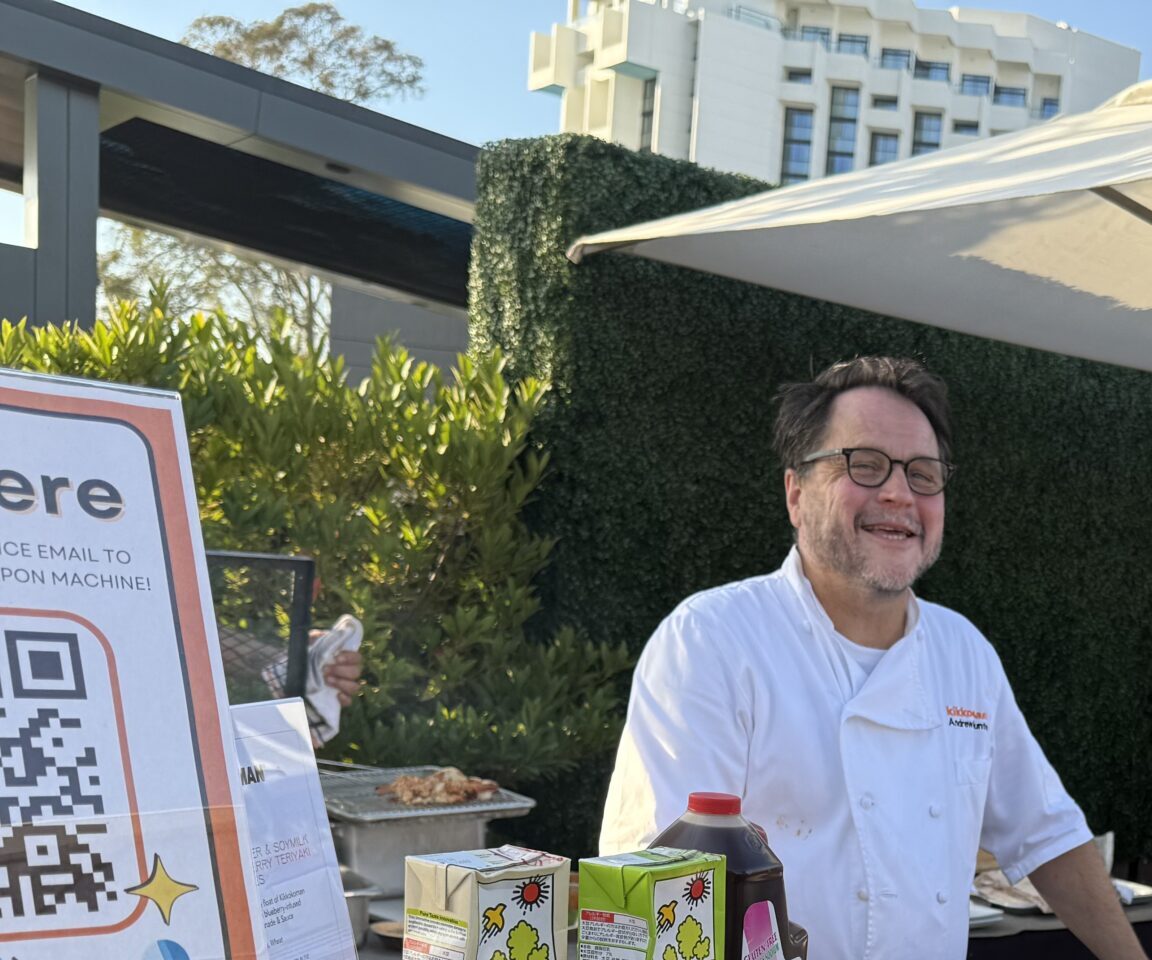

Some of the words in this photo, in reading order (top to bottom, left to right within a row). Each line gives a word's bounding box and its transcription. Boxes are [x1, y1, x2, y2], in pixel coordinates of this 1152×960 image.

[0, 469, 124, 521] ere
[0, 541, 32, 558] CE
[38, 544, 98, 563] EMAIL
[103, 549, 131, 564] TO
[51, 570, 151, 591] MACHINE!
[273, 833, 309, 852] SOYMILK
[275, 848, 311, 866] TERIYAKI
